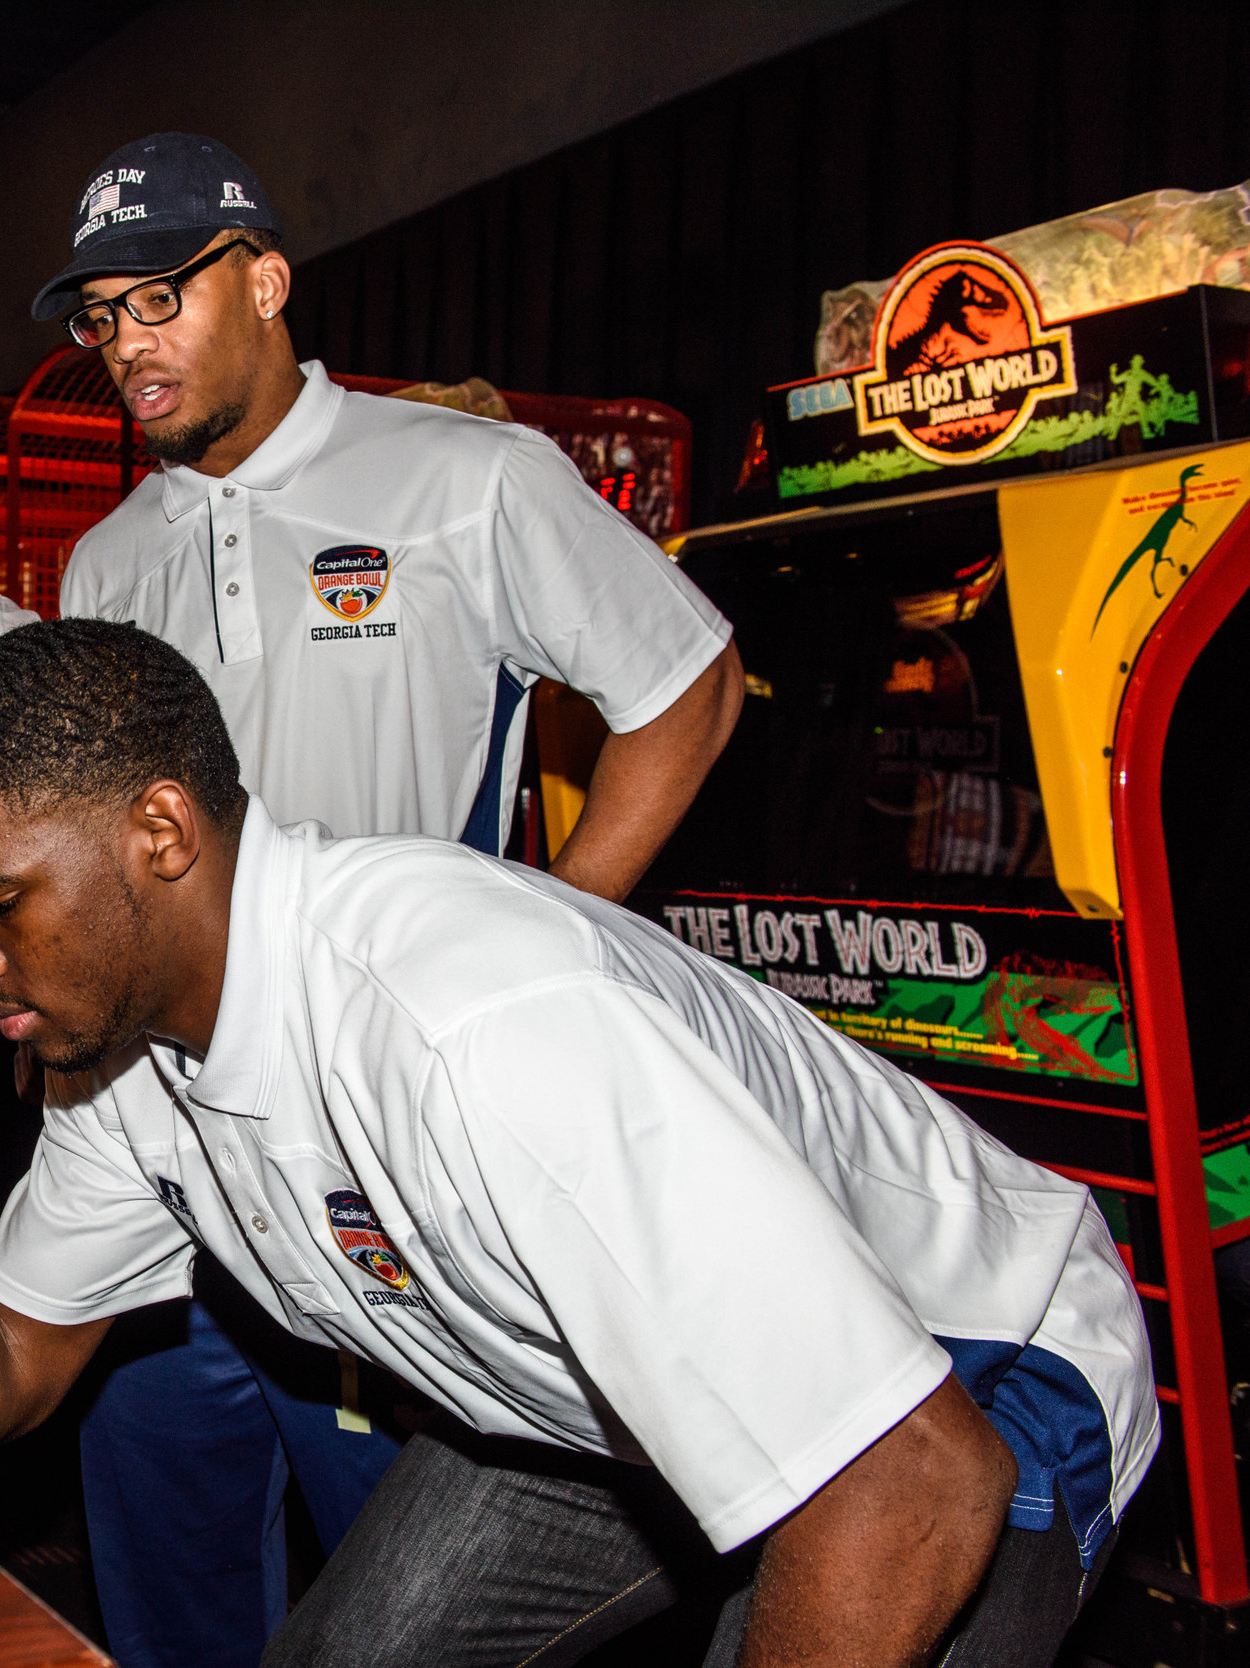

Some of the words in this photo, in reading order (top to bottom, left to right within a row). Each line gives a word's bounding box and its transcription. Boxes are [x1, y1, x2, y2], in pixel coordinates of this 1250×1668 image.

[116, 168, 146, 184] DAY
[220, 199, 257, 209] RUSSELL
[73, 214, 106, 247] GEORGIA
[110, 204, 147, 224] TECH
[868, 380, 913, 417] THE
[911, 368, 965, 412] LOST
[965, 349, 1058, 399] WORLD
[787, 378, 854, 421] SEGA
[967, 398, 995, 418] PARK
[318, 573, 355, 591] ORANGE
[355, 572, 383, 587] BOWL
[311, 625, 362, 641] GEORGIA
[364, 623, 396, 637] TECH
[664, 906, 735, 957] THE
[734, 904, 822, 966] LOST
[824, 909, 987, 979] WORLD
[767, 969, 829, 999] JURASSIC
[828, 973, 876, 1005] PARK
[885, 1032, 929, 1049] running
[930, 1036, 952, 1049] and
[362, 1291, 419, 1309] GEORGIA
